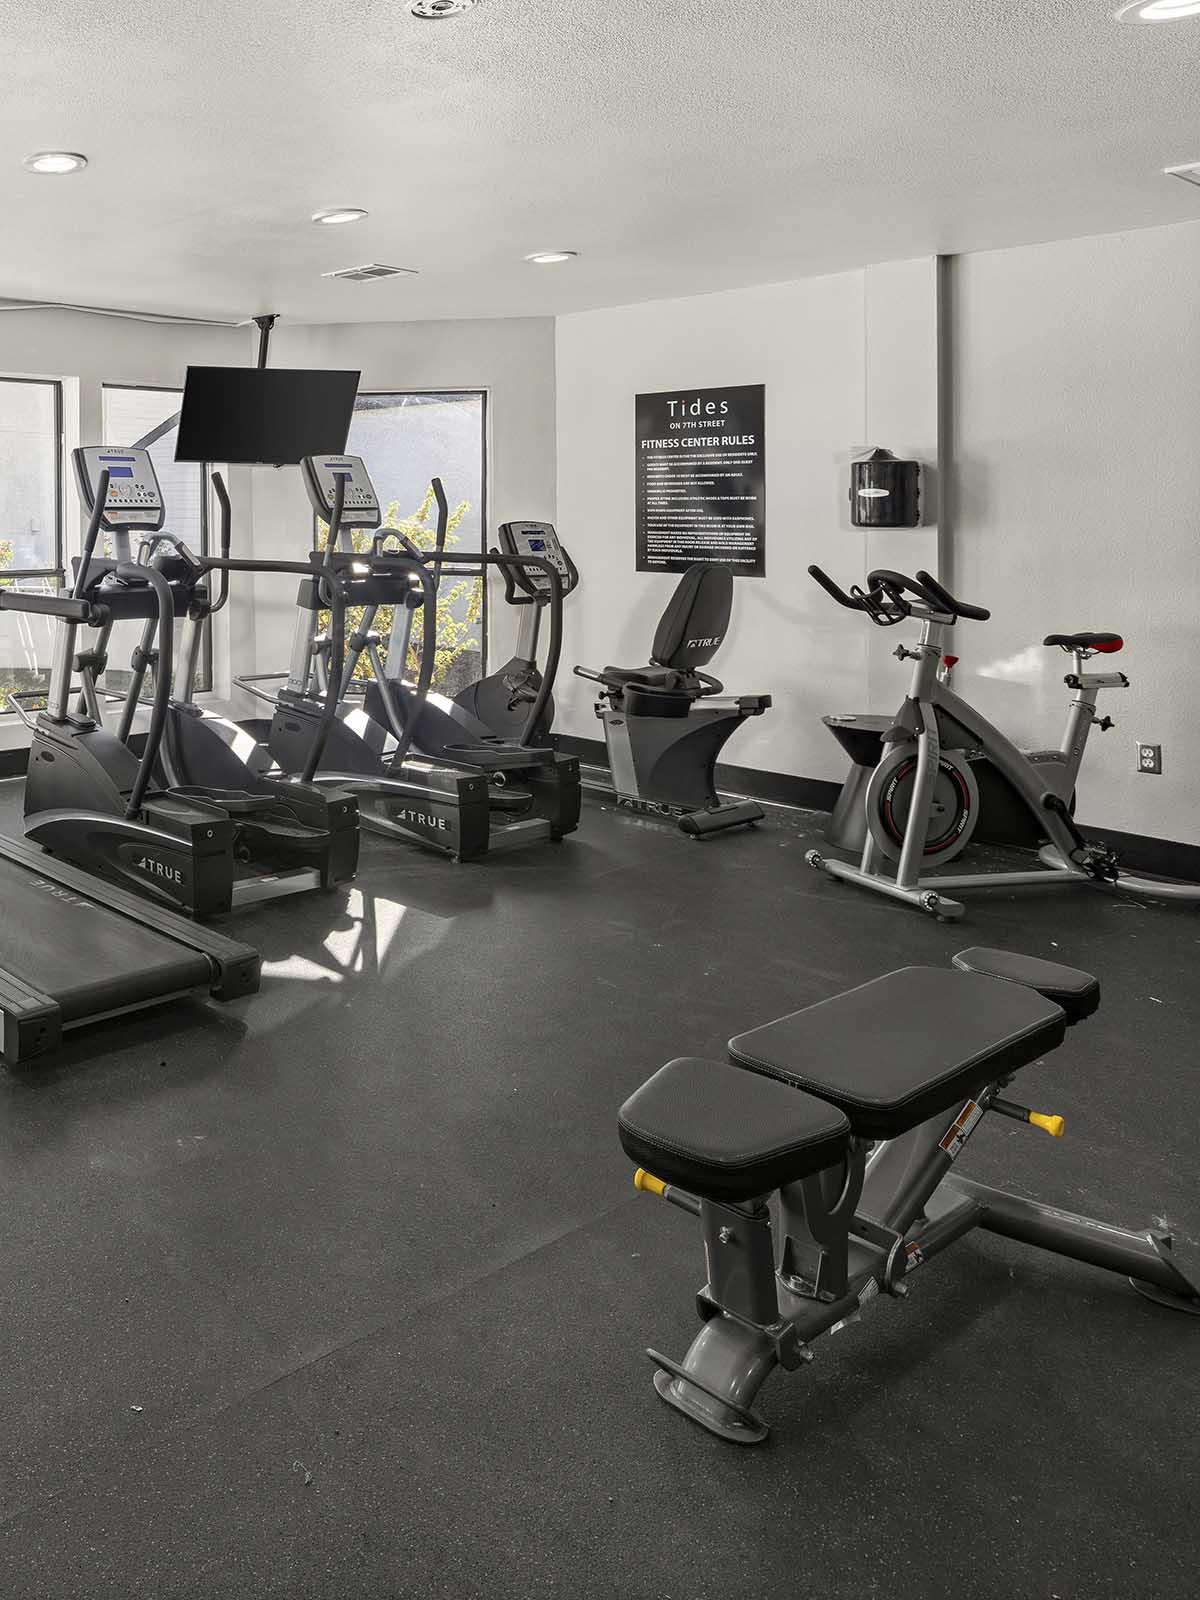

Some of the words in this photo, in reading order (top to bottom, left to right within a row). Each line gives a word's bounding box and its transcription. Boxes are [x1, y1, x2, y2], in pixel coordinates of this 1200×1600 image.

[666, 398, 729, 417] Tides
[669, 421, 681, 430] ON
[682, 421, 697, 429] 7TH
[698, 419, 726, 429] STREET
[641, 438, 679, 449] FITNESS
[681, 436, 720, 448] CENTER
[721, 434, 755, 446] RULES
[407, 810, 446, 830] TRUE
[147, 858, 182, 884] TRUE
[29, 879, 77, 903] TRUE
